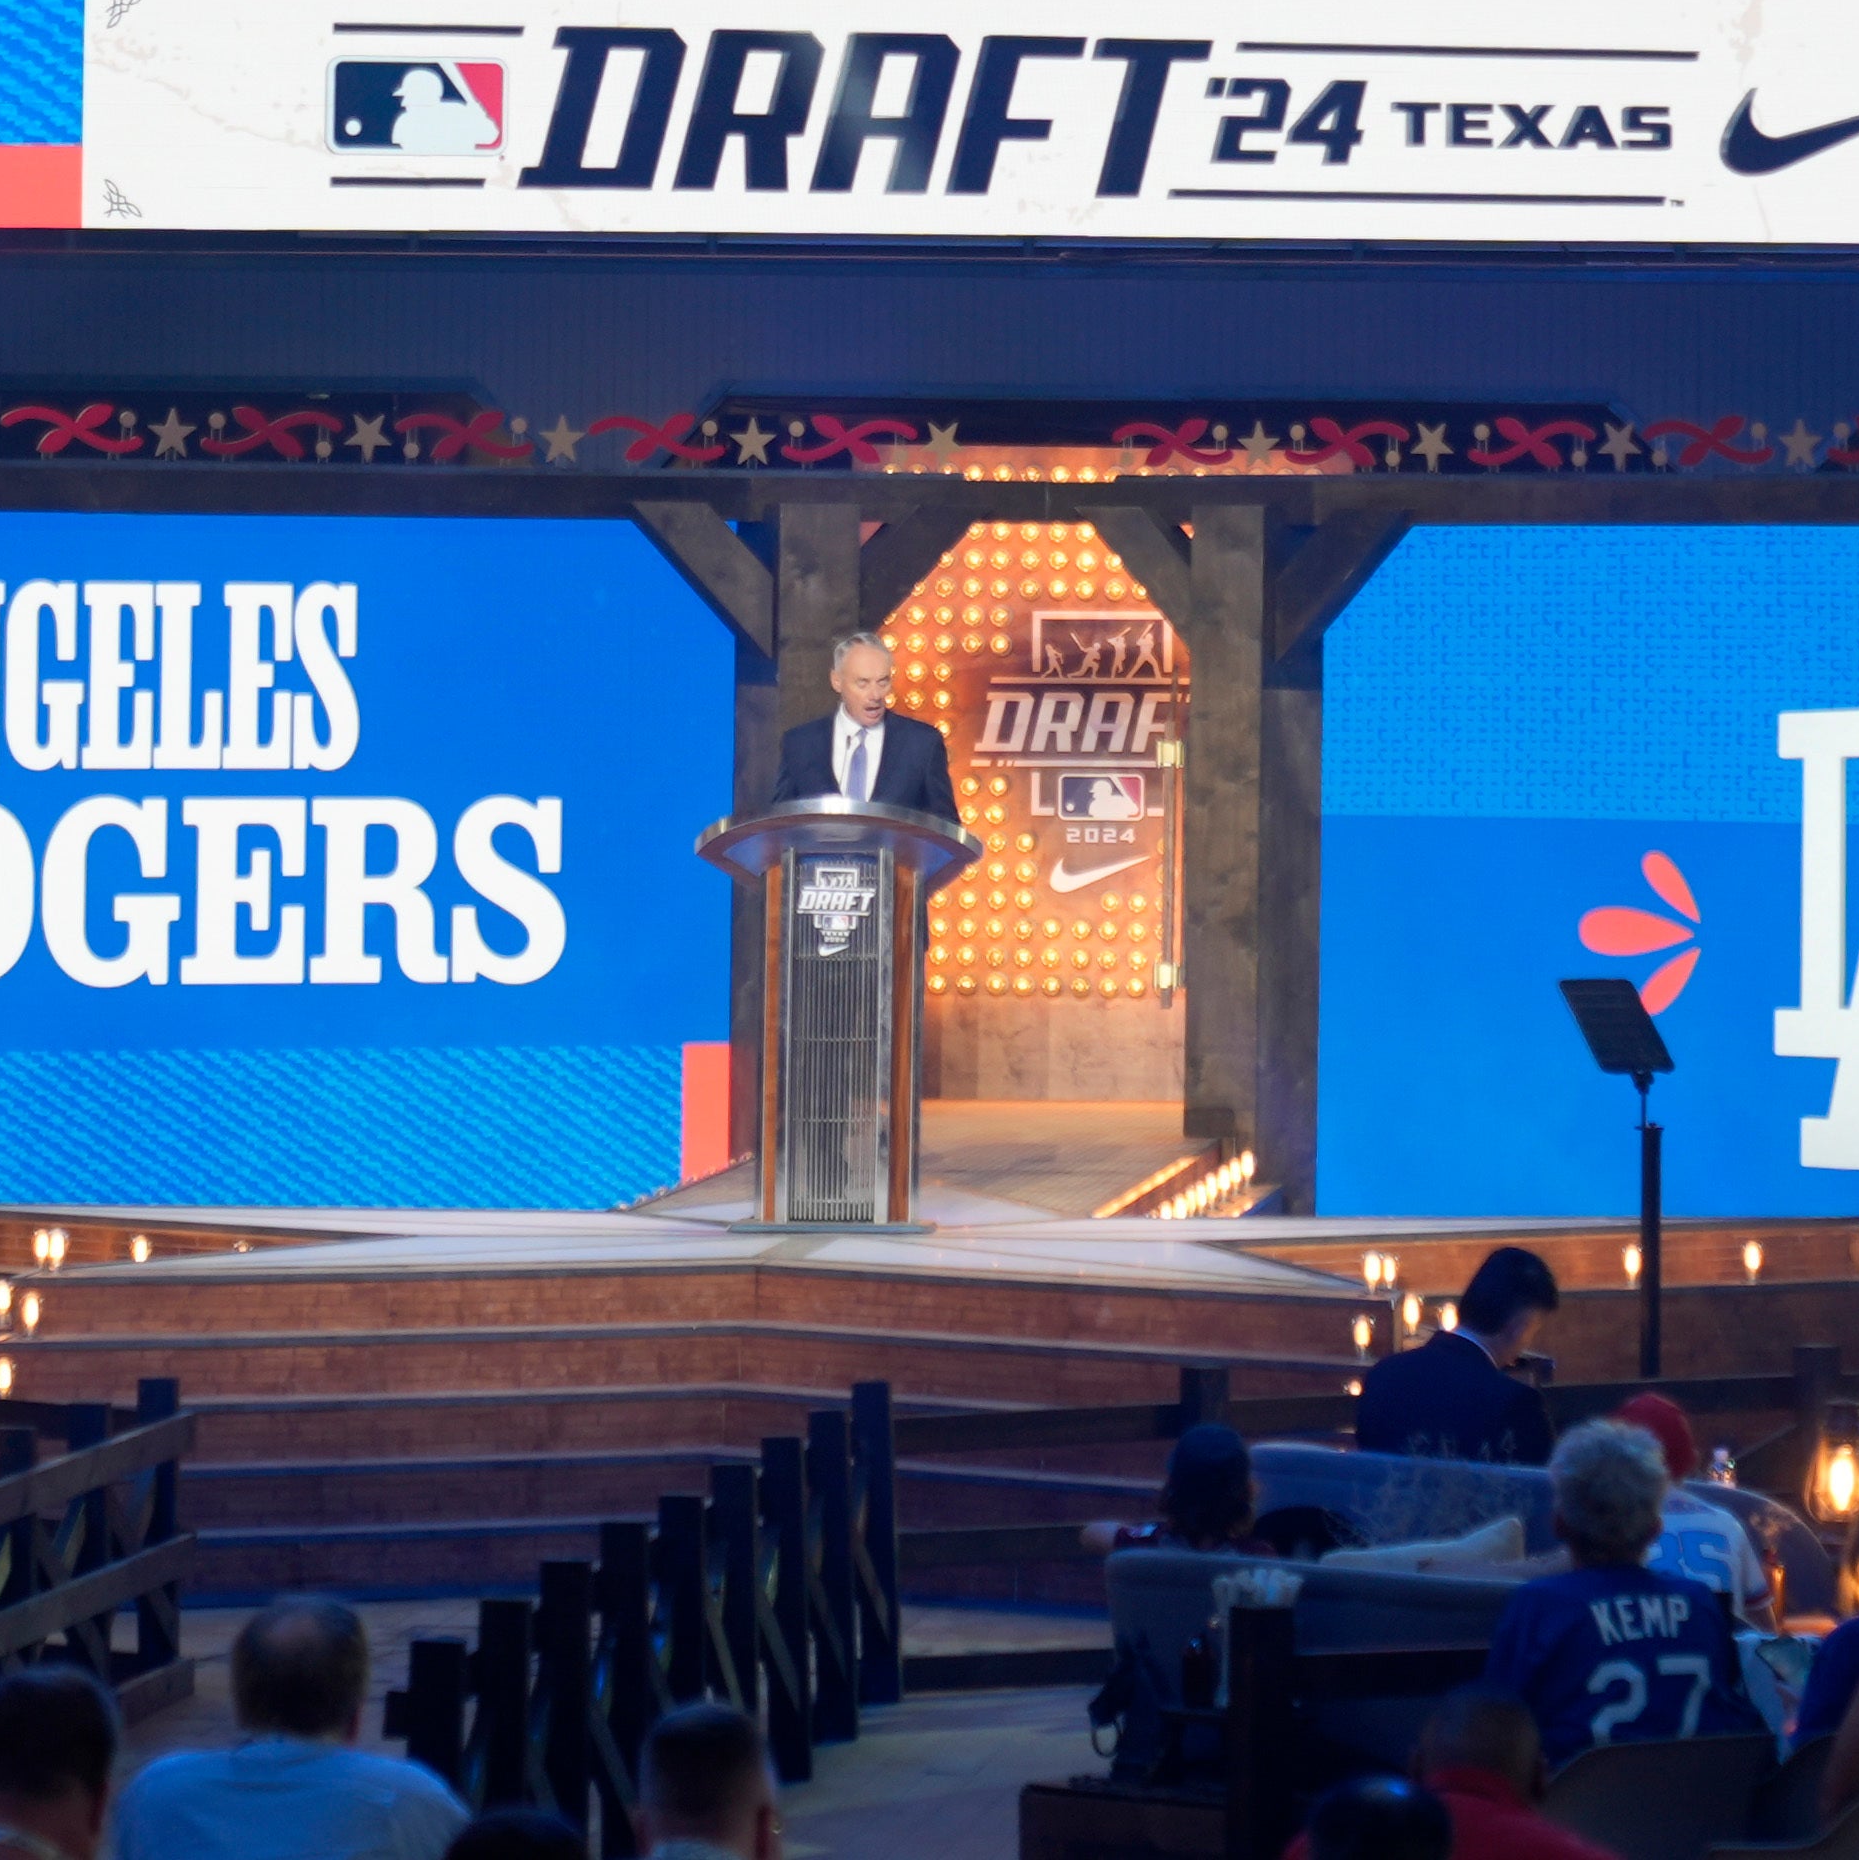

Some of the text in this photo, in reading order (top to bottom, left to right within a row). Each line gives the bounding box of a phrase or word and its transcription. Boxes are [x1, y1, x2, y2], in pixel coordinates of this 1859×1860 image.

[517, 26, 1214, 199] DRAFT
[1390, 101, 1672, 151] TEXAS
[974, 692, 1190, 755] DRAF
[1066, 827, 1136, 844] 2024
[798, 890, 875, 912] DRAFT
[1590, 1595, 1691, 1647] KEMP
[1588, 1655, 1711, 1741] 27
